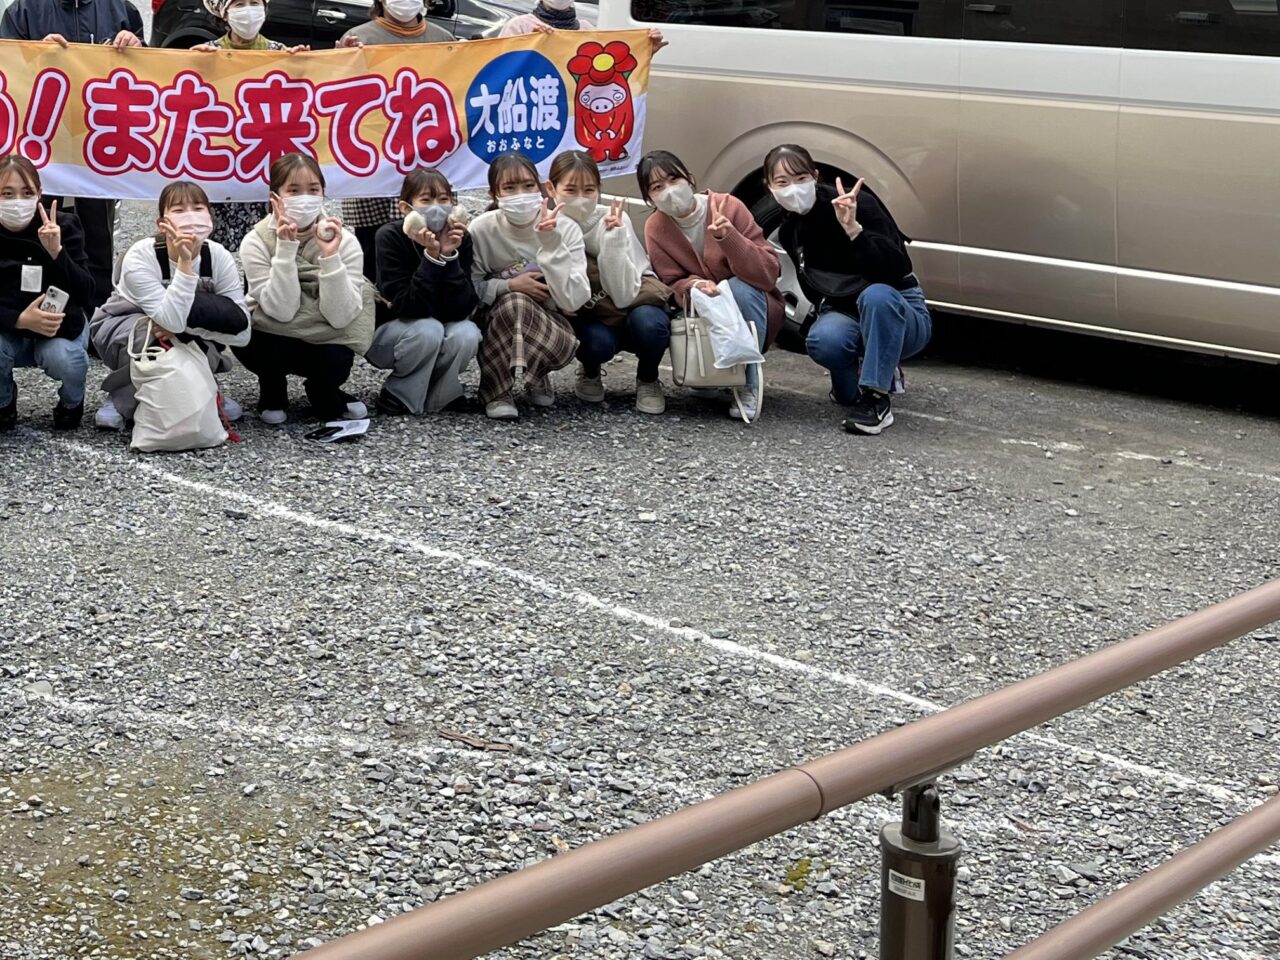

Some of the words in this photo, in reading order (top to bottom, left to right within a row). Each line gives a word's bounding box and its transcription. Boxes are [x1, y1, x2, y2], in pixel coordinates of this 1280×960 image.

[83, 67, 462, 184] また来てね
[470, 74, 560, 138] 大船渡
[486, 136, 545, 153] おおふなと
